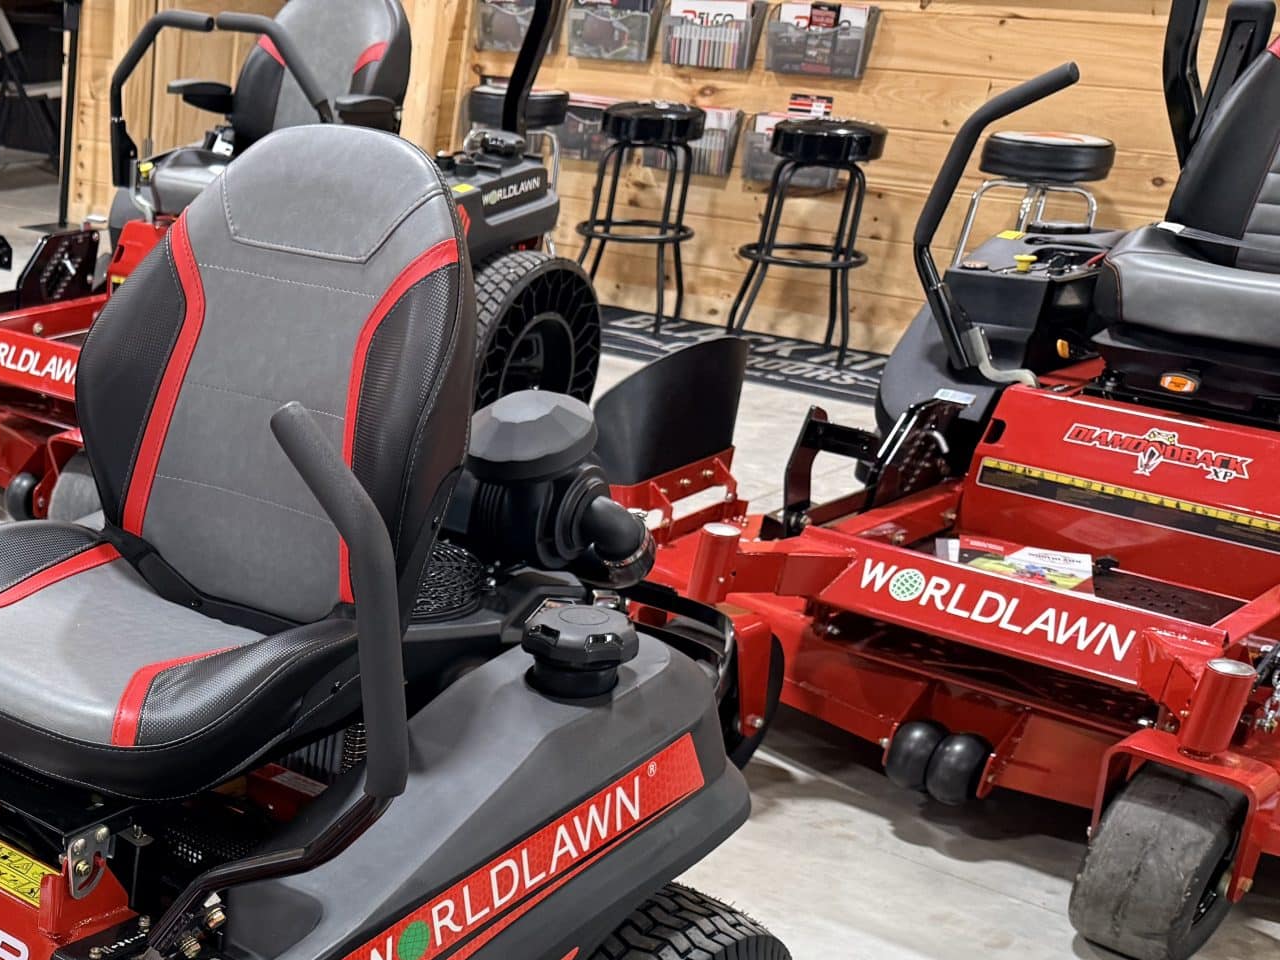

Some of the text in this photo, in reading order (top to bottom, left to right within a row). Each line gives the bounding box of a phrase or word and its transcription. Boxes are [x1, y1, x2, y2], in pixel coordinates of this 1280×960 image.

[482, 176, 540, 206] WORLDLAWN
[1066, 426, 1250, 476] DIAMONDBACK
[1211, 468, 1234, 481] XP
[860, 558, 1136, 662] WORLDLAWN
